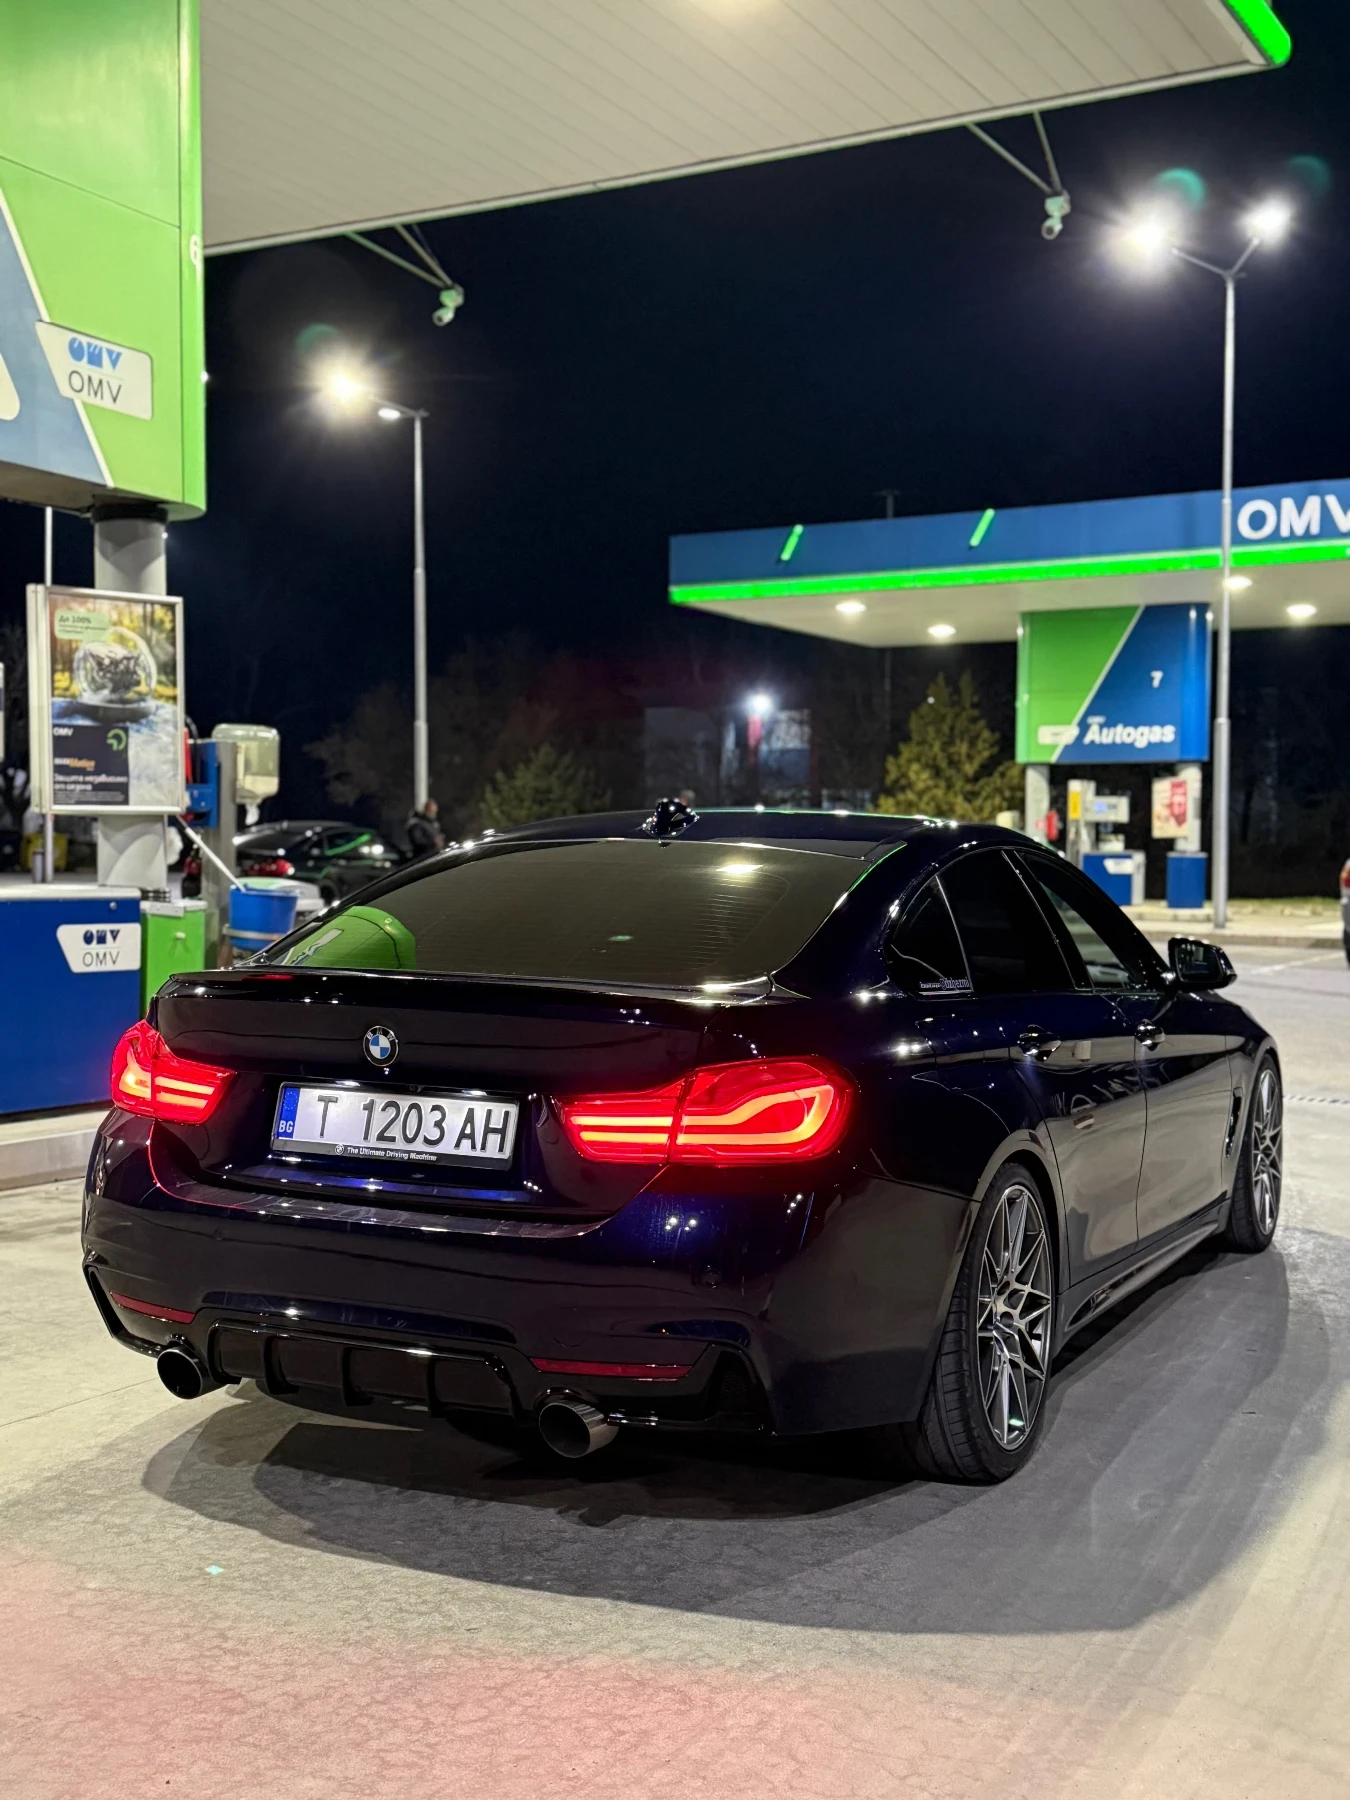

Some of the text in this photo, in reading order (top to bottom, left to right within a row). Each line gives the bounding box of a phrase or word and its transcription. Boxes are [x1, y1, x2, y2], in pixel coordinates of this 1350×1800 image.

[68, 370, 122, 404] OMV
[1237, 494, 1350, 540] OMV
[1150, 670, 1164, 689] 7
[53, 727, 74, 737] OMV
[1083, 723, 1176, 749] Autogas
[82, 951, 120, 968] OMV
[278, 1120, 294, 1133] BG
[317, 1094, 511, 1153] T 1203 AH
[347, 1146, 437, 1161] The Ultimate Driving Machine
